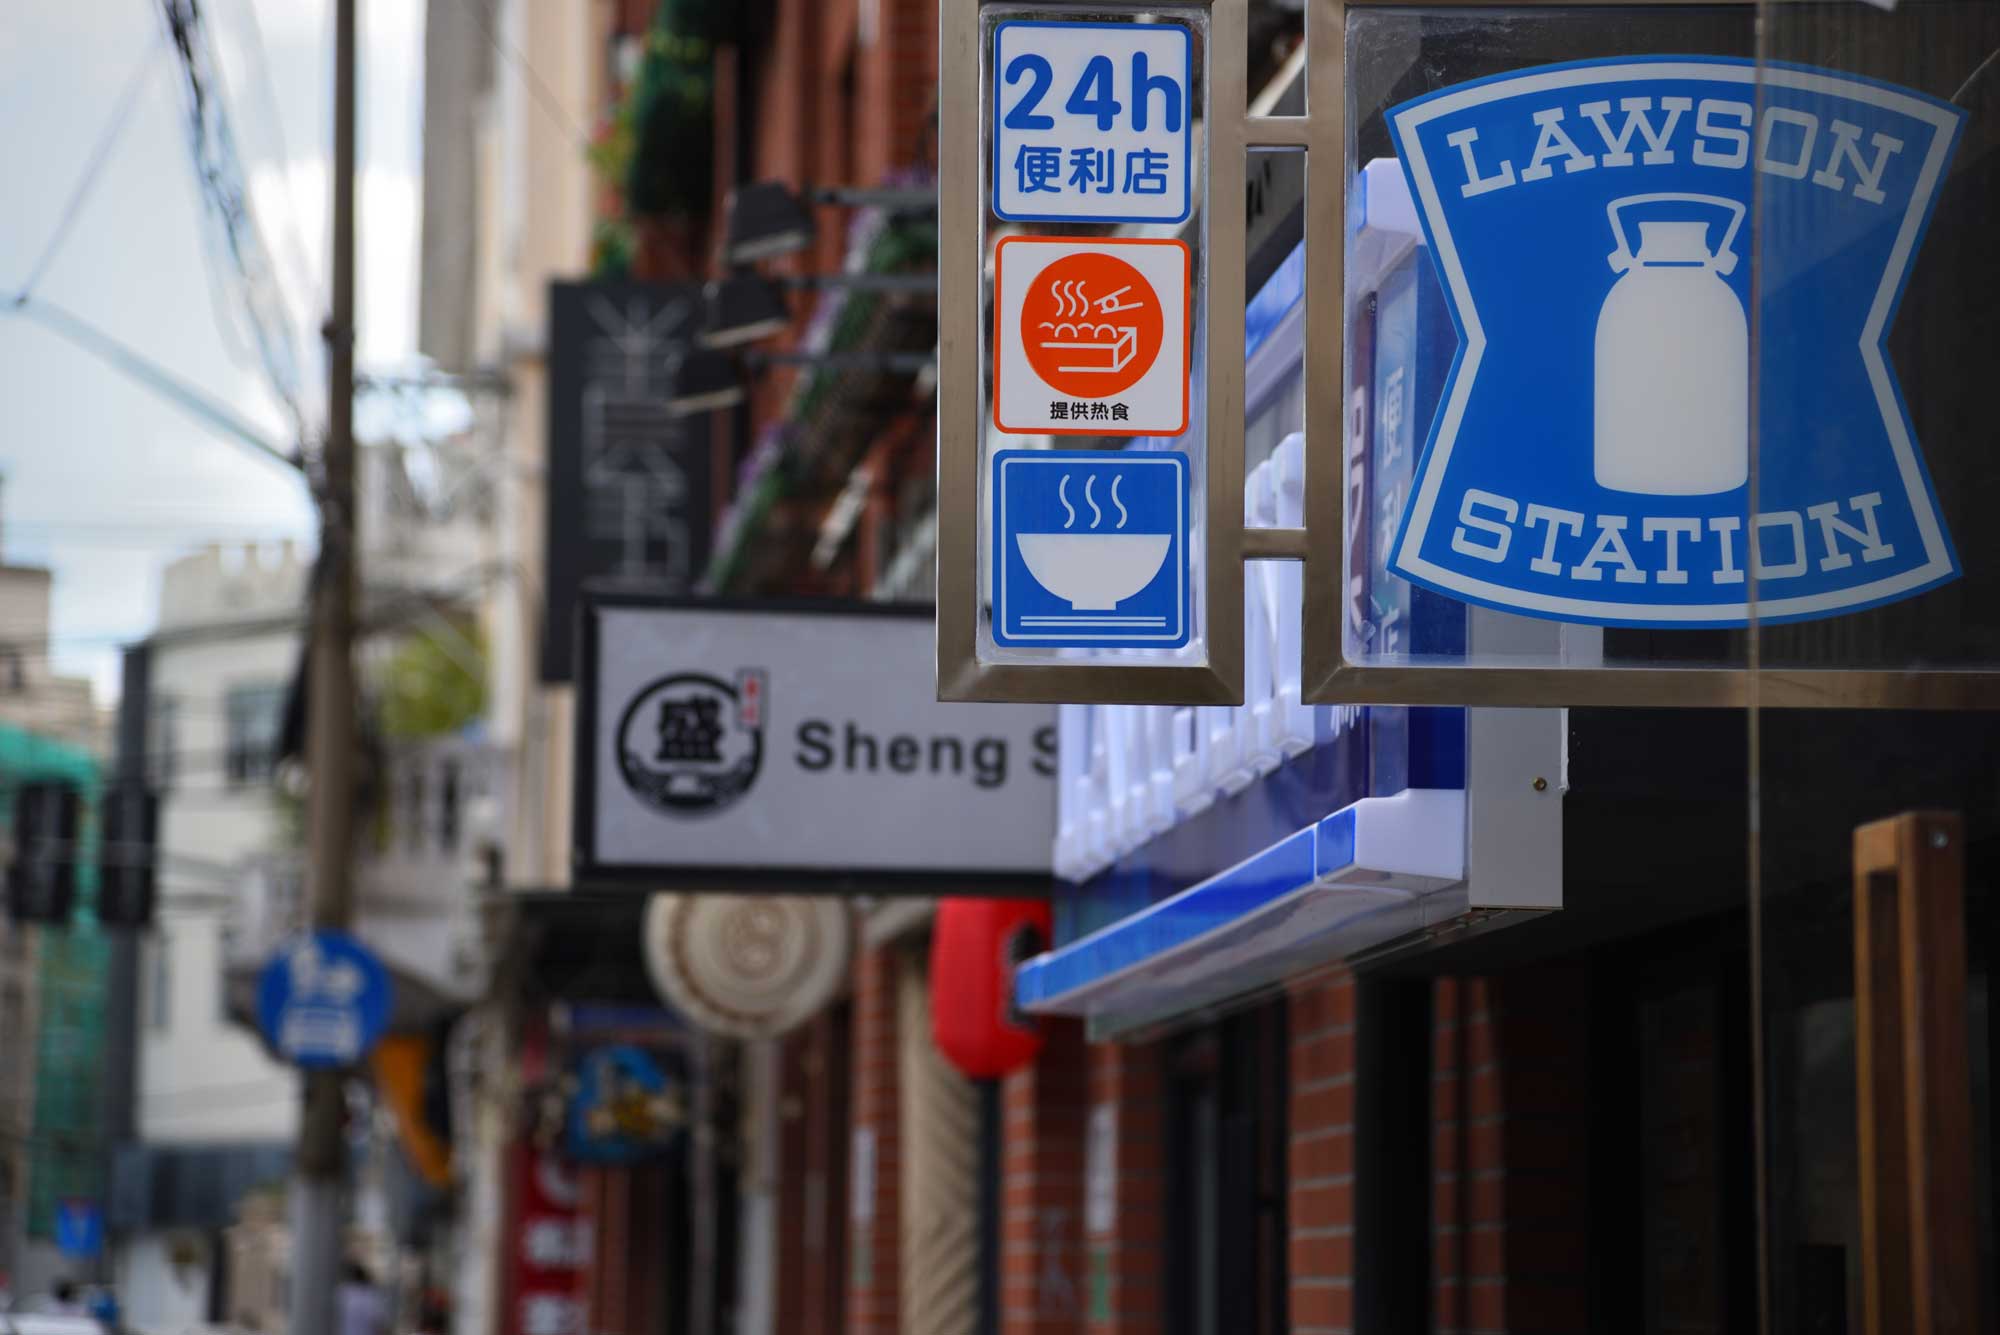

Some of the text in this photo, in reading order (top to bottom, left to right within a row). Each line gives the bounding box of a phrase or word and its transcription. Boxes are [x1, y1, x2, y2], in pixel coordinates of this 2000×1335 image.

[1004, 51, 1182, 133] 24h
[1015, 144, 1169, 194] 便利店
[1447, 97, 1904, 204] LAWSON
[1050, 401, 1129, 421] 提供热食
[1451, 488, 1896, 584] STATION
[794, 720, 1008, 790] Sheng
